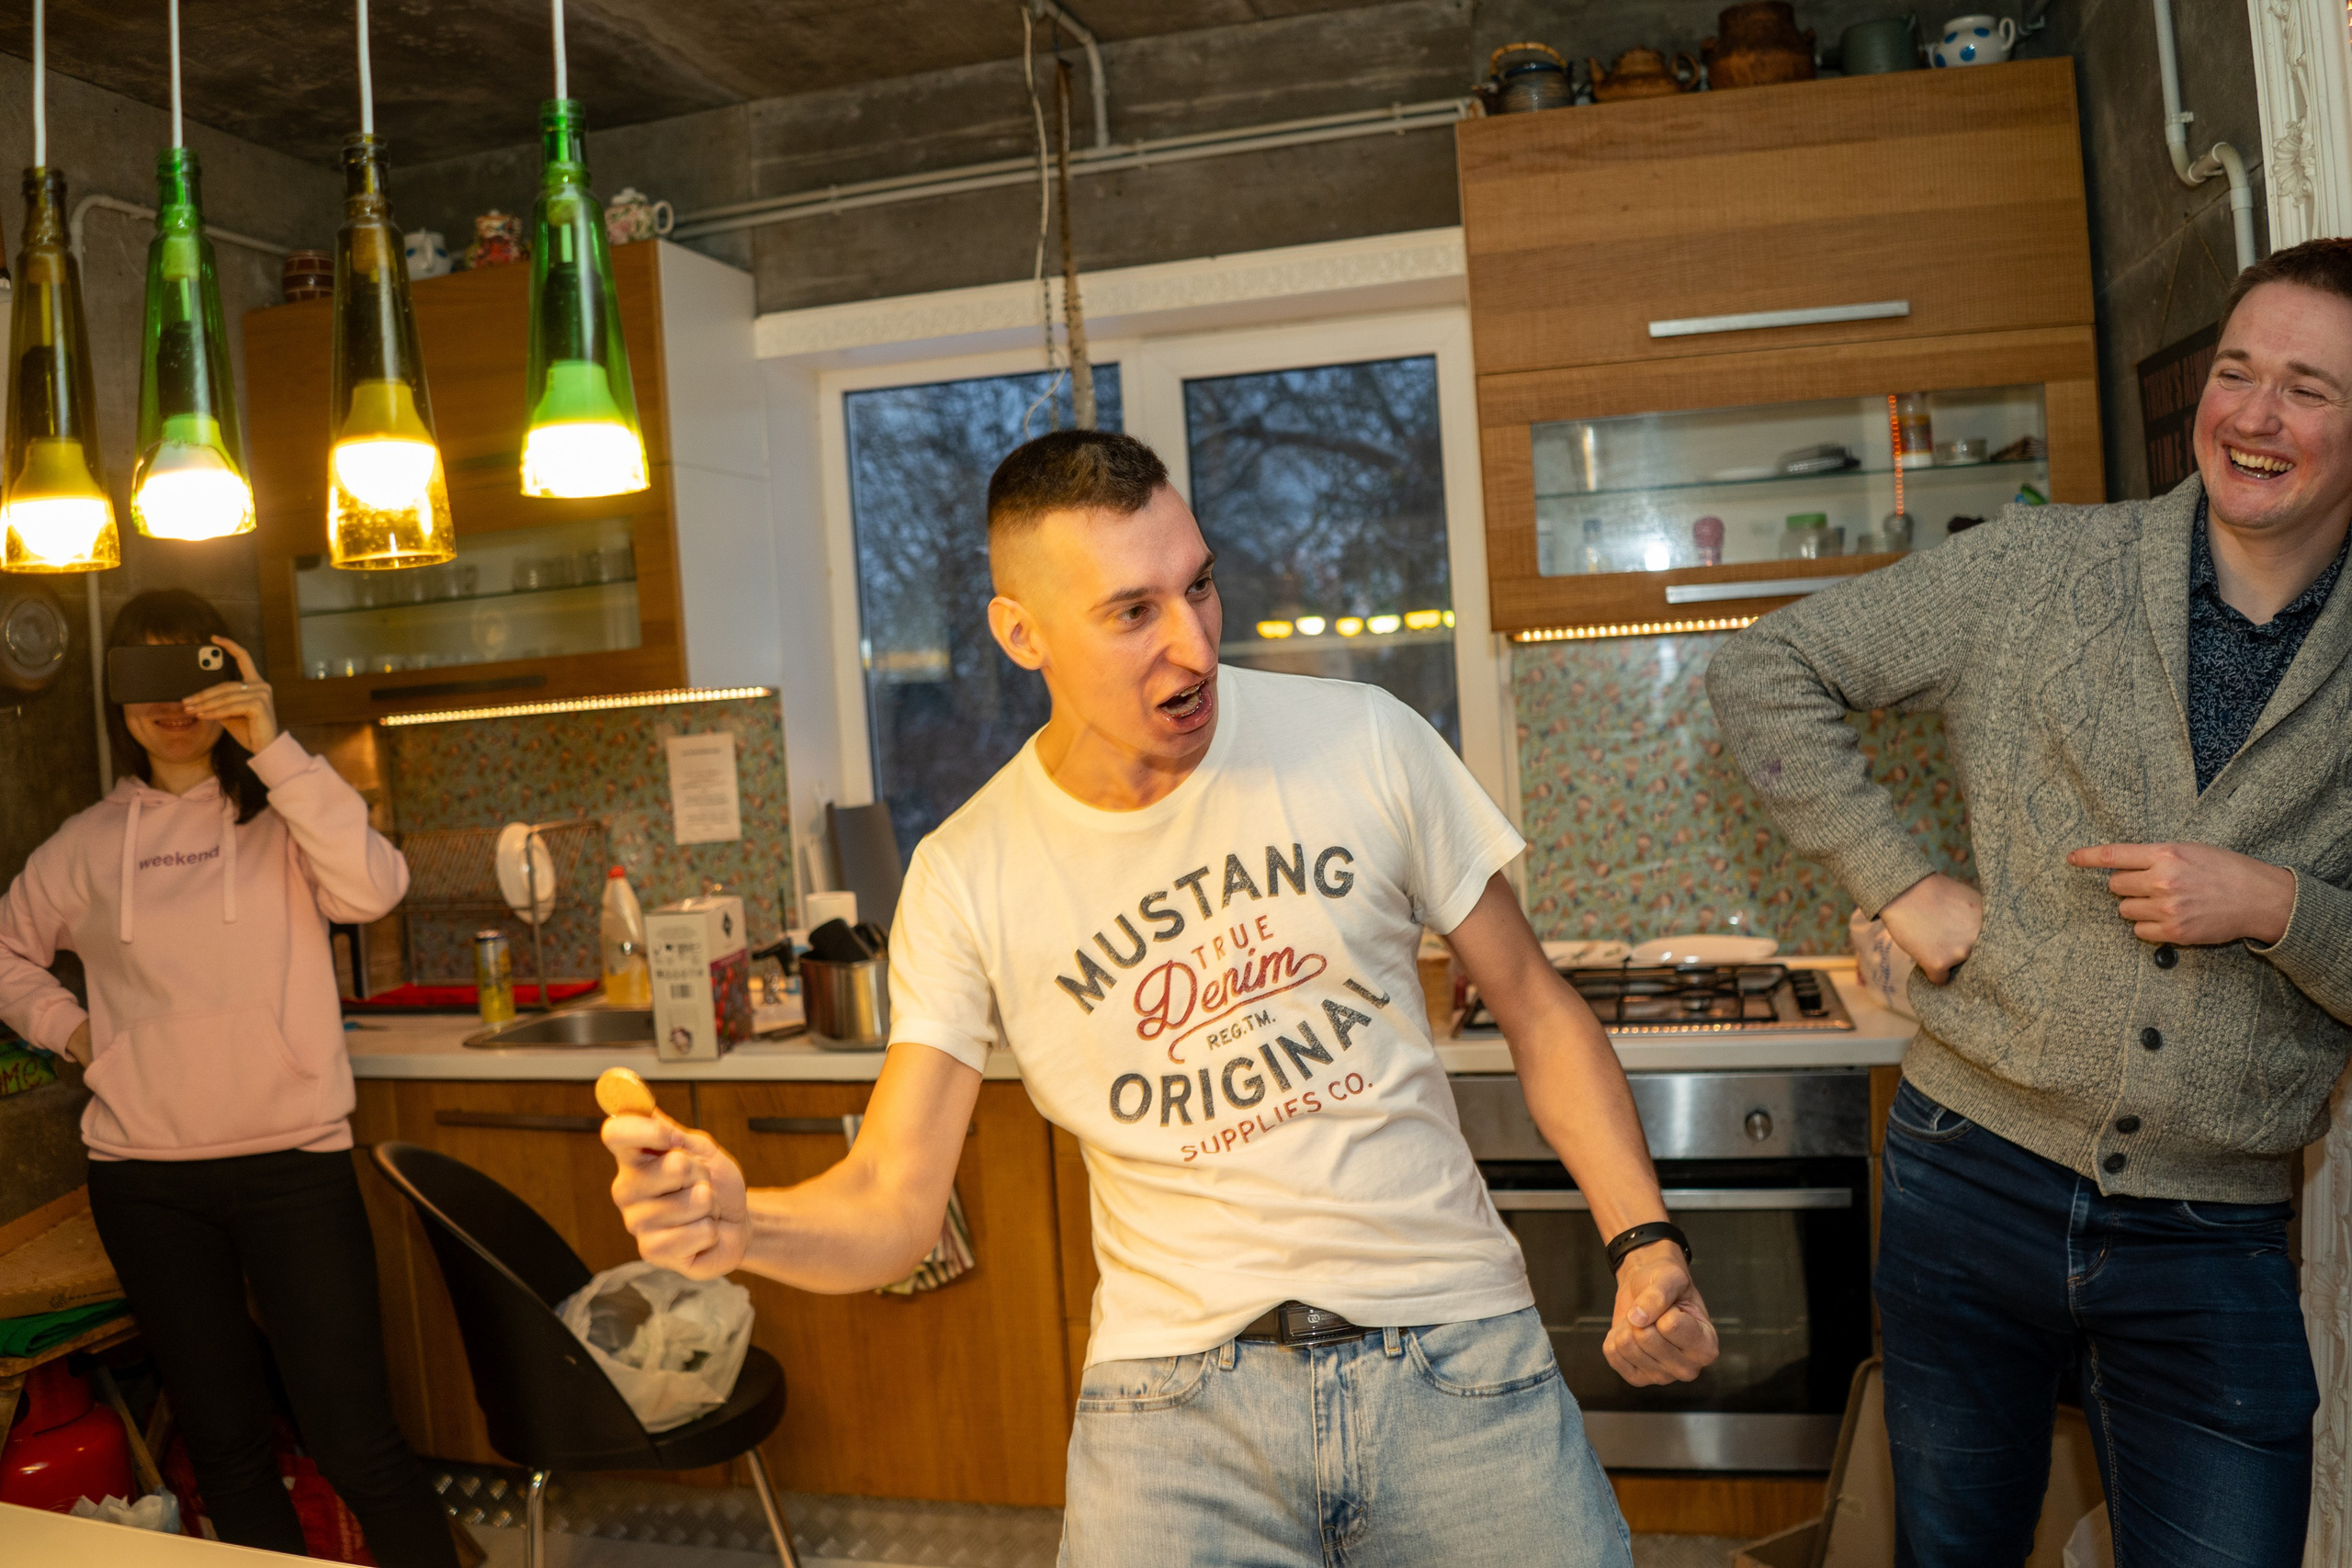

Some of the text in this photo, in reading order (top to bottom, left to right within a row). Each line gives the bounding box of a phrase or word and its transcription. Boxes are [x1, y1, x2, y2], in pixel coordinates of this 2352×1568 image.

[139, 845, 220, 870] weekend
[1054, 842, 1355, 1016] MUSTANG
[1191, 914, 1274, 971] TRUE
[1134, 945, 1327, 1042] Denim
[1109, 977, 1391, 1127] ORIGINAL
[1181, 1071, 1374, 1162] SUPPLIES CO.
